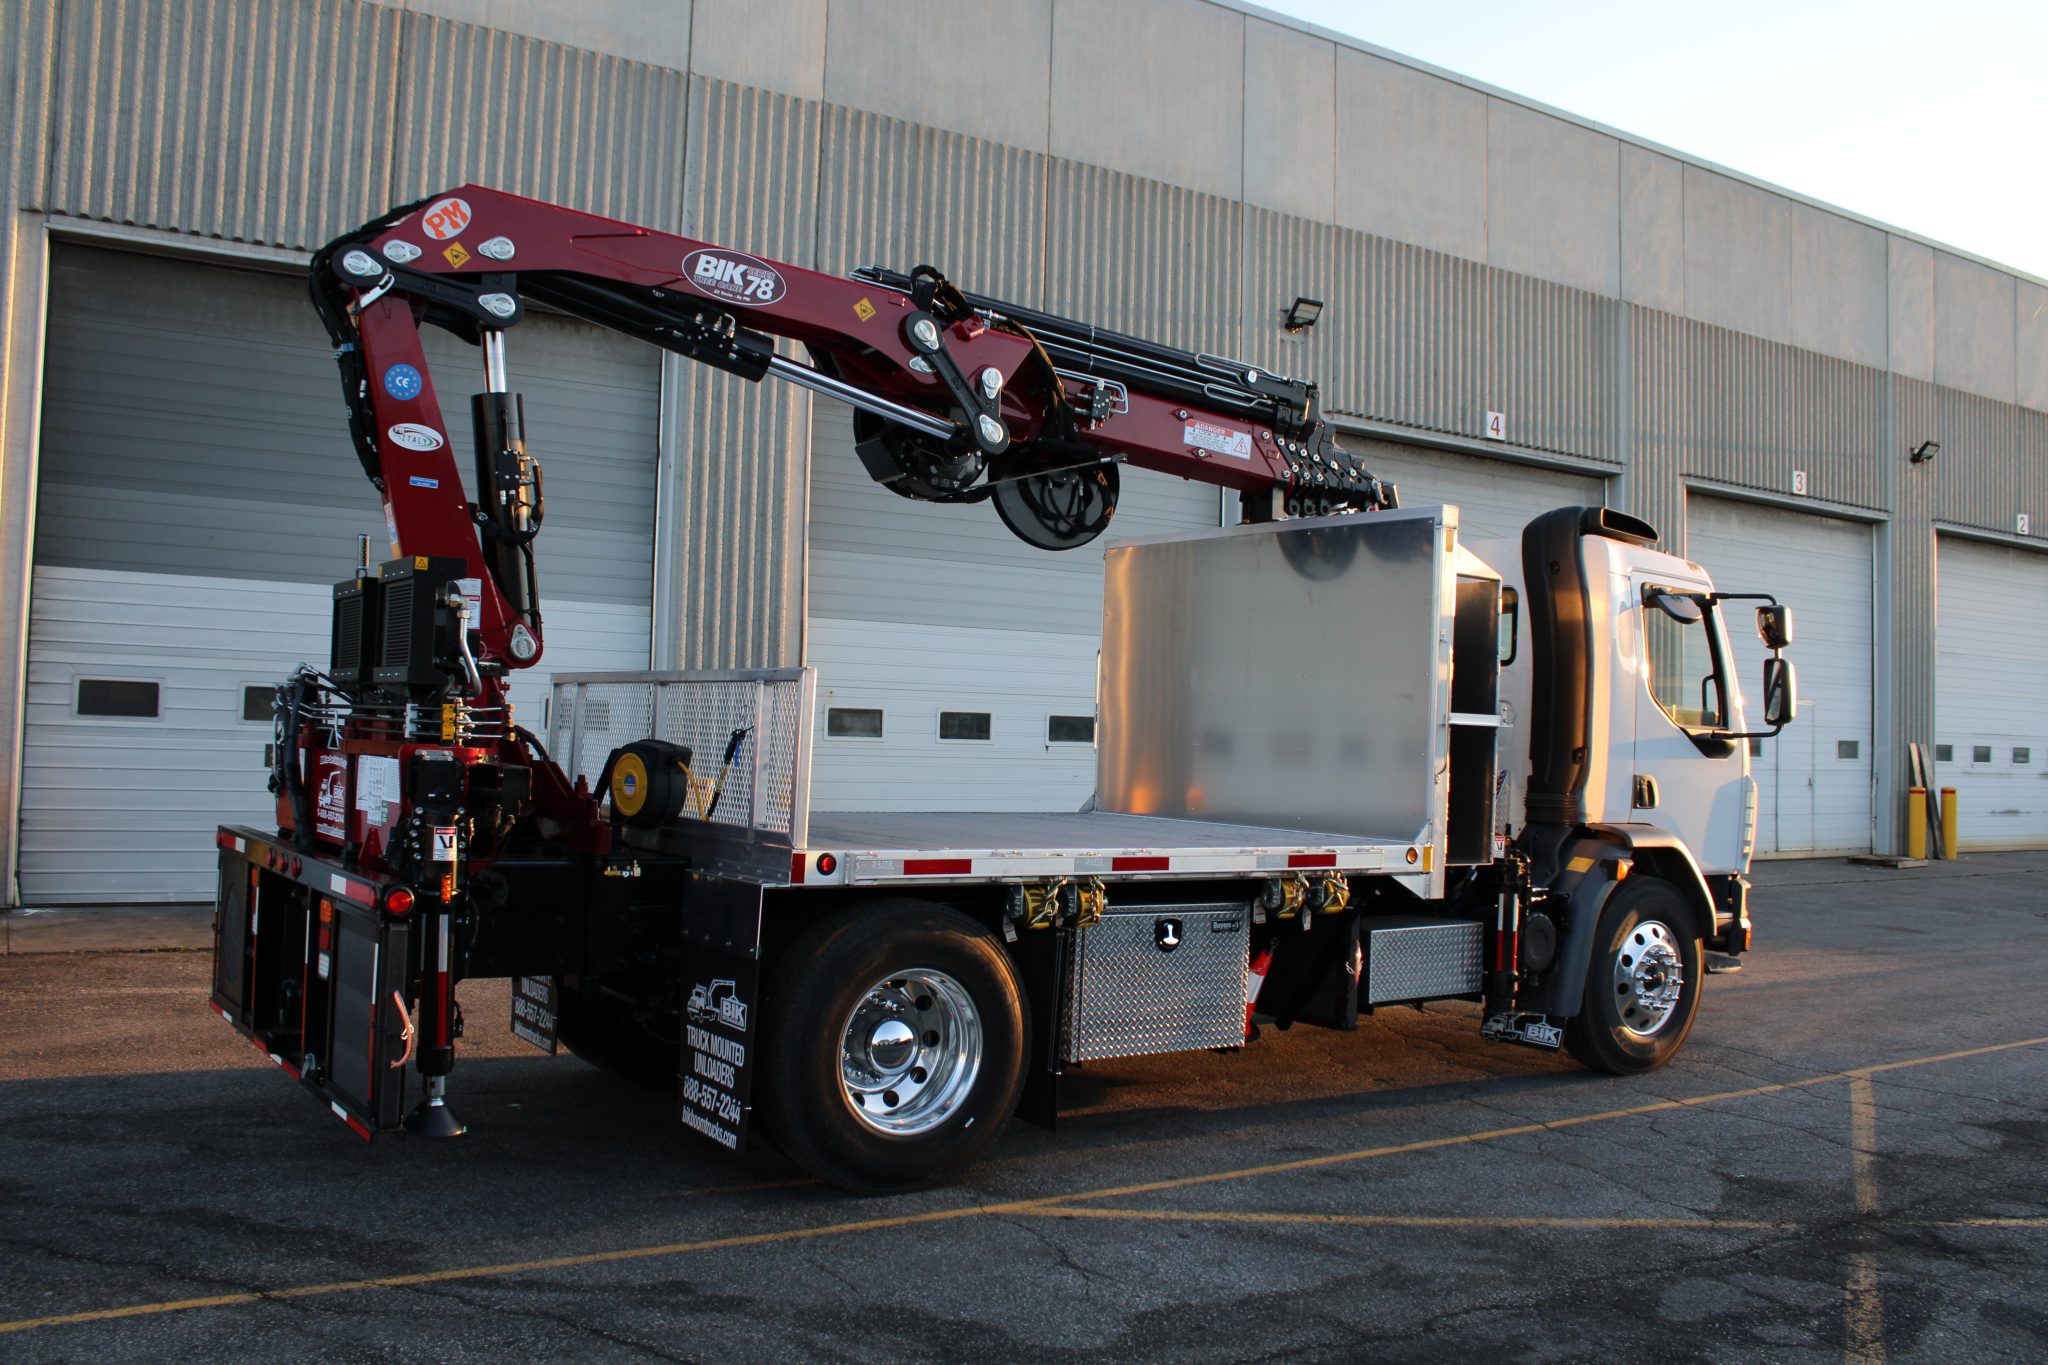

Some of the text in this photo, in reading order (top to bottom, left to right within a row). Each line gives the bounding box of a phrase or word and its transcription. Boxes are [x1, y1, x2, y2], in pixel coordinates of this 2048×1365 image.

[425, 200, 469, 239] PM
[695, 254, 749, 286] BIK
[746, 266, 776, 280] SERIES
[694, 274, 744, 293] TREE CARE
[744, 275, 775, 300] 78
[1200, 423, 1226, 436] DANGER
[1490, 415, 1501, 436] 4
[402, 434, 427, 446] ITALY
[1796, 473, 1803, 492] 3
[2019, 516, 2026, 533] 2
[722, 1000, 745, 1022] BIK
[1527, 1025, 1558, 1044] BIK
[686, 1024, 745, 1068] TRUCK MOUNTED
[694, 1051, 735, 1089] UNLOADERS
[683, 1075, 741, 1125] 888-557-2244
[682, 1105, 737, 1150] bikboomtrucks.com
